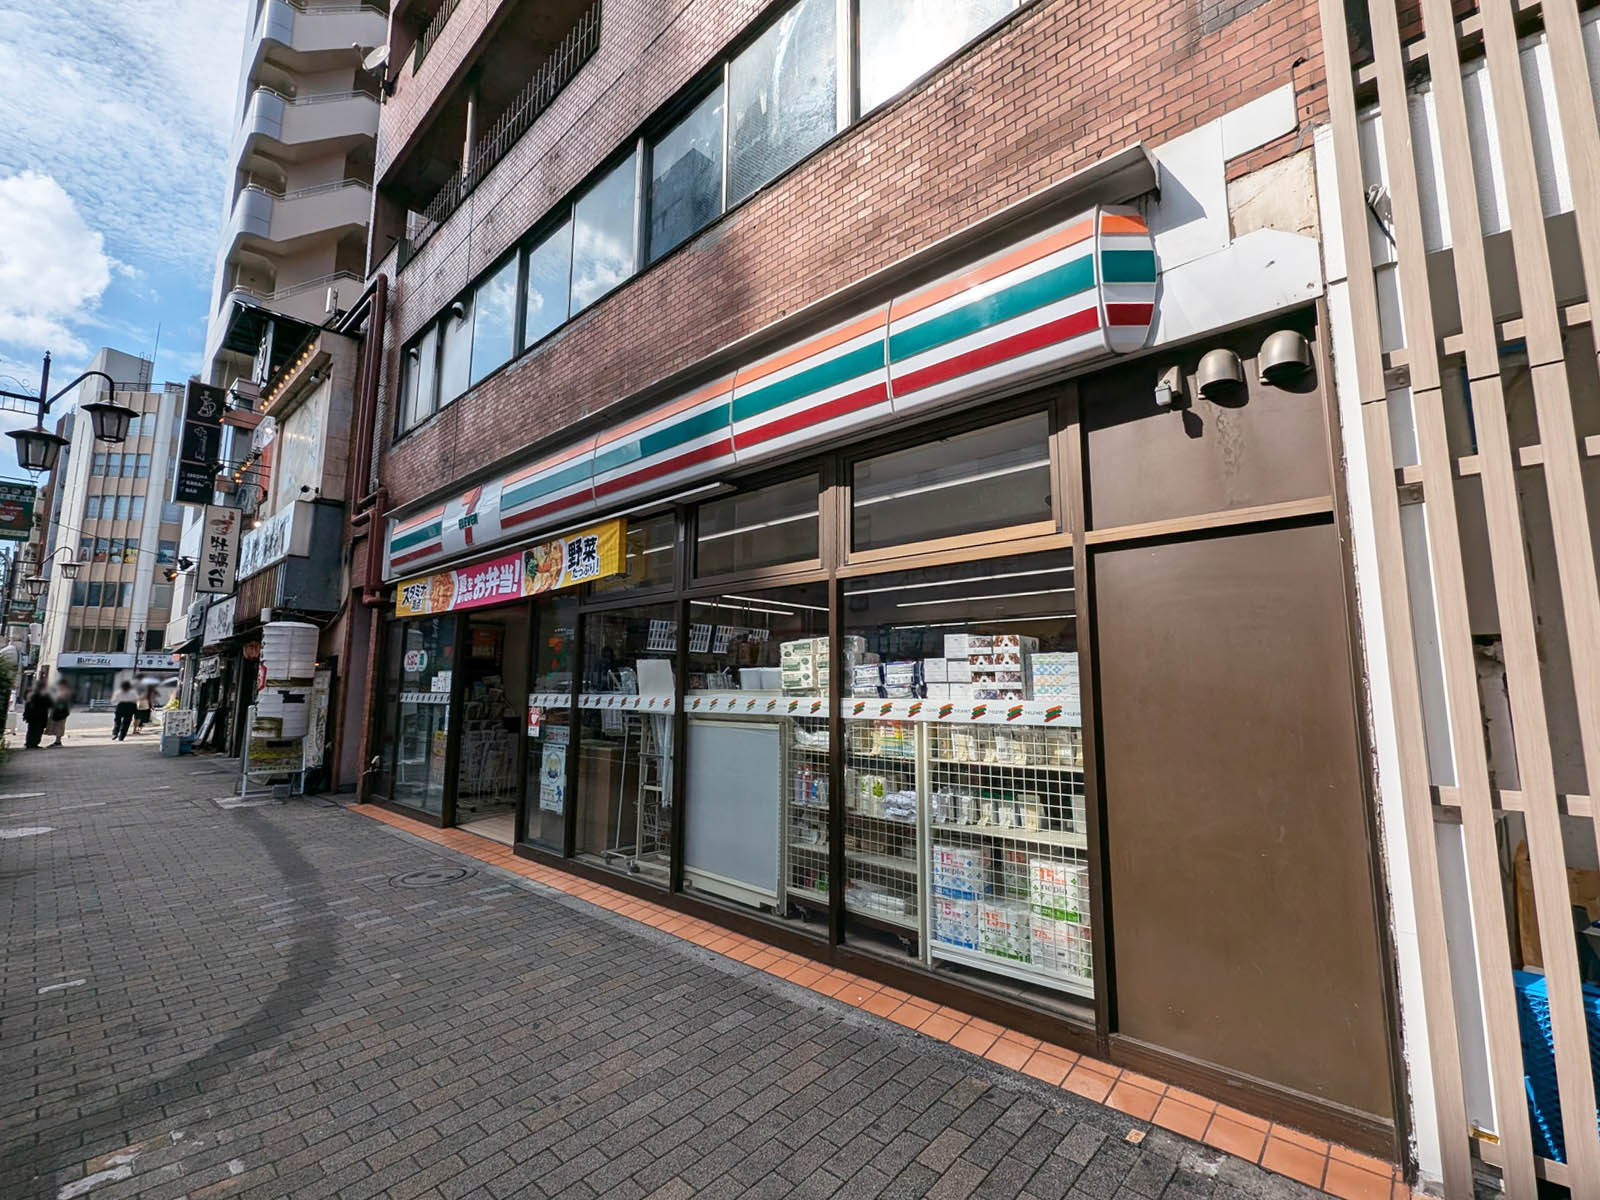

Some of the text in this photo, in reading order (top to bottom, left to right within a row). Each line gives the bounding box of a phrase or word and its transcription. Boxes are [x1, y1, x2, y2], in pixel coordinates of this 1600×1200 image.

[568, 537, 598, 570] 野菜
[401, 584, 427, 606] スタミナ
